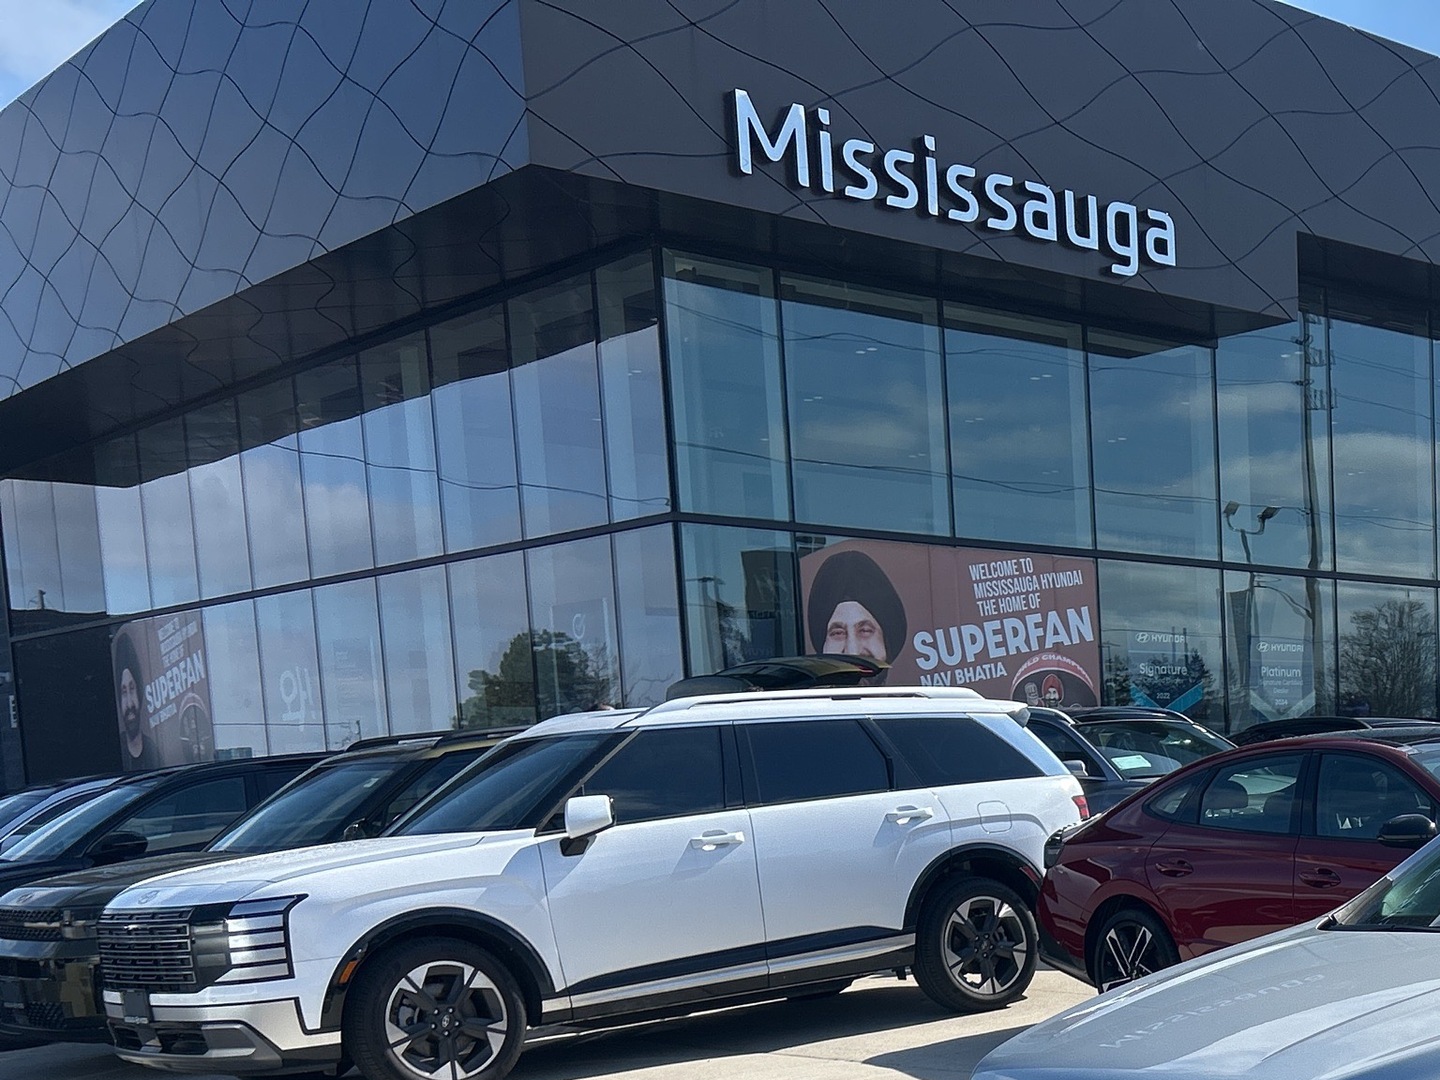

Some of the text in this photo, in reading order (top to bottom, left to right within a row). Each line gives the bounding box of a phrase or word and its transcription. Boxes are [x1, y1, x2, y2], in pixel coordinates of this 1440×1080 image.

[733, 88, 1177, 277] Mississauga
[968, 557, 1034, 581] WELCOME TO
[973, 569, 1084, 600] MISSISSAUGA HYUNDAI
[976, 592, 1041, 617] THE HOME OF
[912, 605, 1095, 671] SUPERFAN
[1271, 643, 1304, 652] HYUNDAI
[145, 648, 205, 714] SUPERFAN
[920, 661, 1008, 687] NAV BHATIA
[1139, 662, 1188, 677] Signature
[1261, 666, 1301, 677] Platinum
